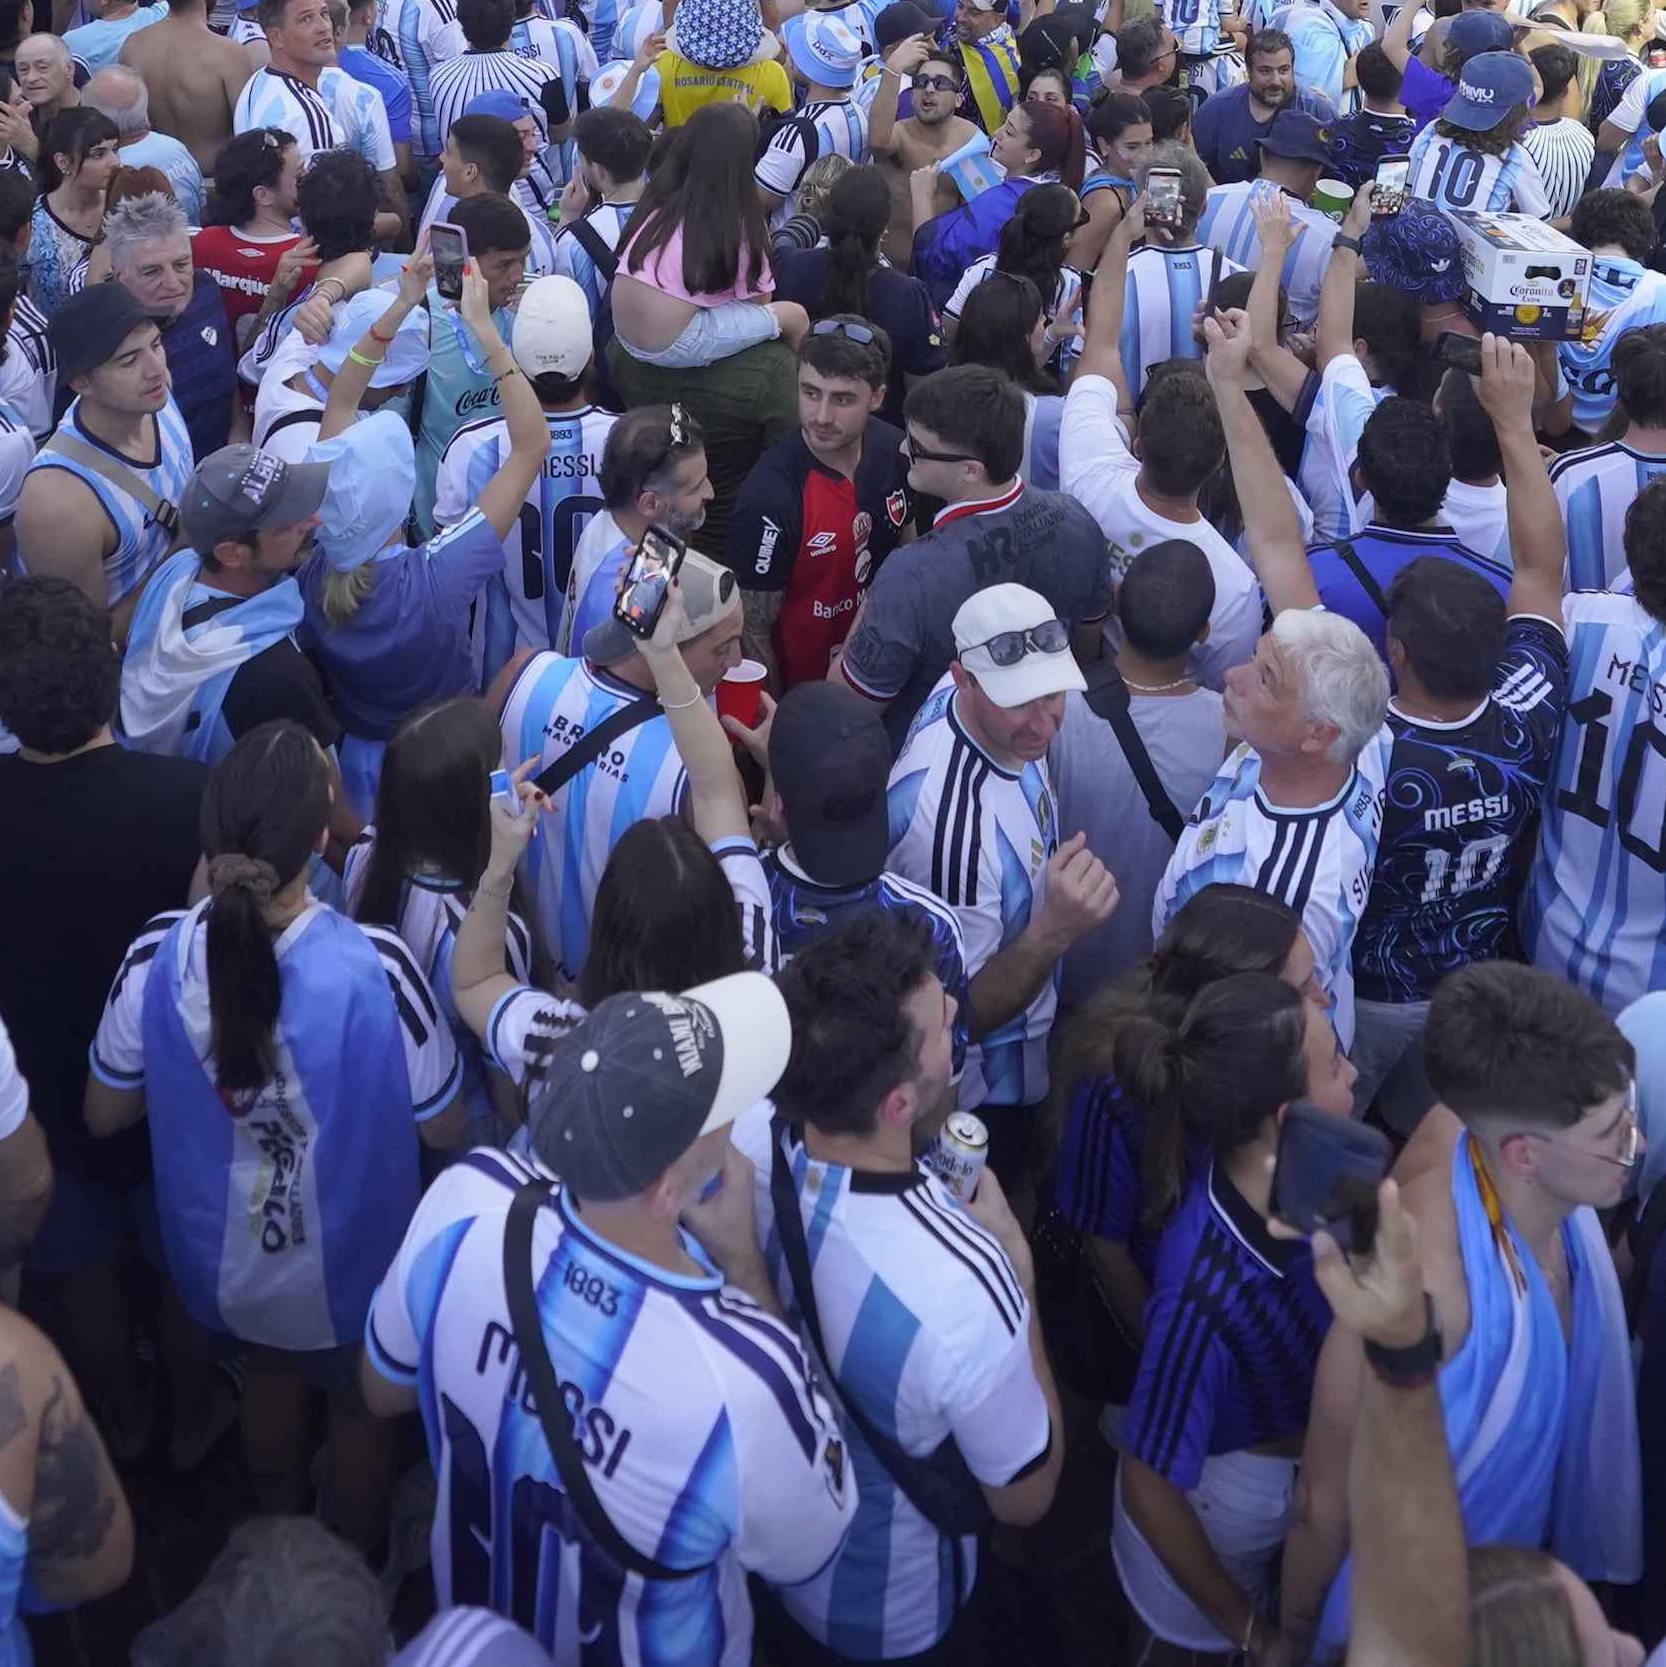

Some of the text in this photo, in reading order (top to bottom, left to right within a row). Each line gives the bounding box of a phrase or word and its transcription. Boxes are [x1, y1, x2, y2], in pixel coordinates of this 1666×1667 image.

[514, 42, 541, 60] ESSI
[674, 76, 756, 96] ROSARIO CENTRAL
[1427, 144, 1486, 208] 10
[1509, 284, 1555, 299] Coronita
[455, 380, 502, 417] Coca-C
[809, 544, 837, 557] umbro
[812, 598, 854, 619] Banco
[552, 714, 626, 768] BRNO
[1424, 793, 1511, 832] MESSI
[1420, 833, 1512, 904] 10
[668, 1018, 703, 1080] MIAMI
[938, 1152, 974, 1178] odelo
[562, 1259, 622, 1319] 1893
[476, 1320, 633, 1479] MSSI
